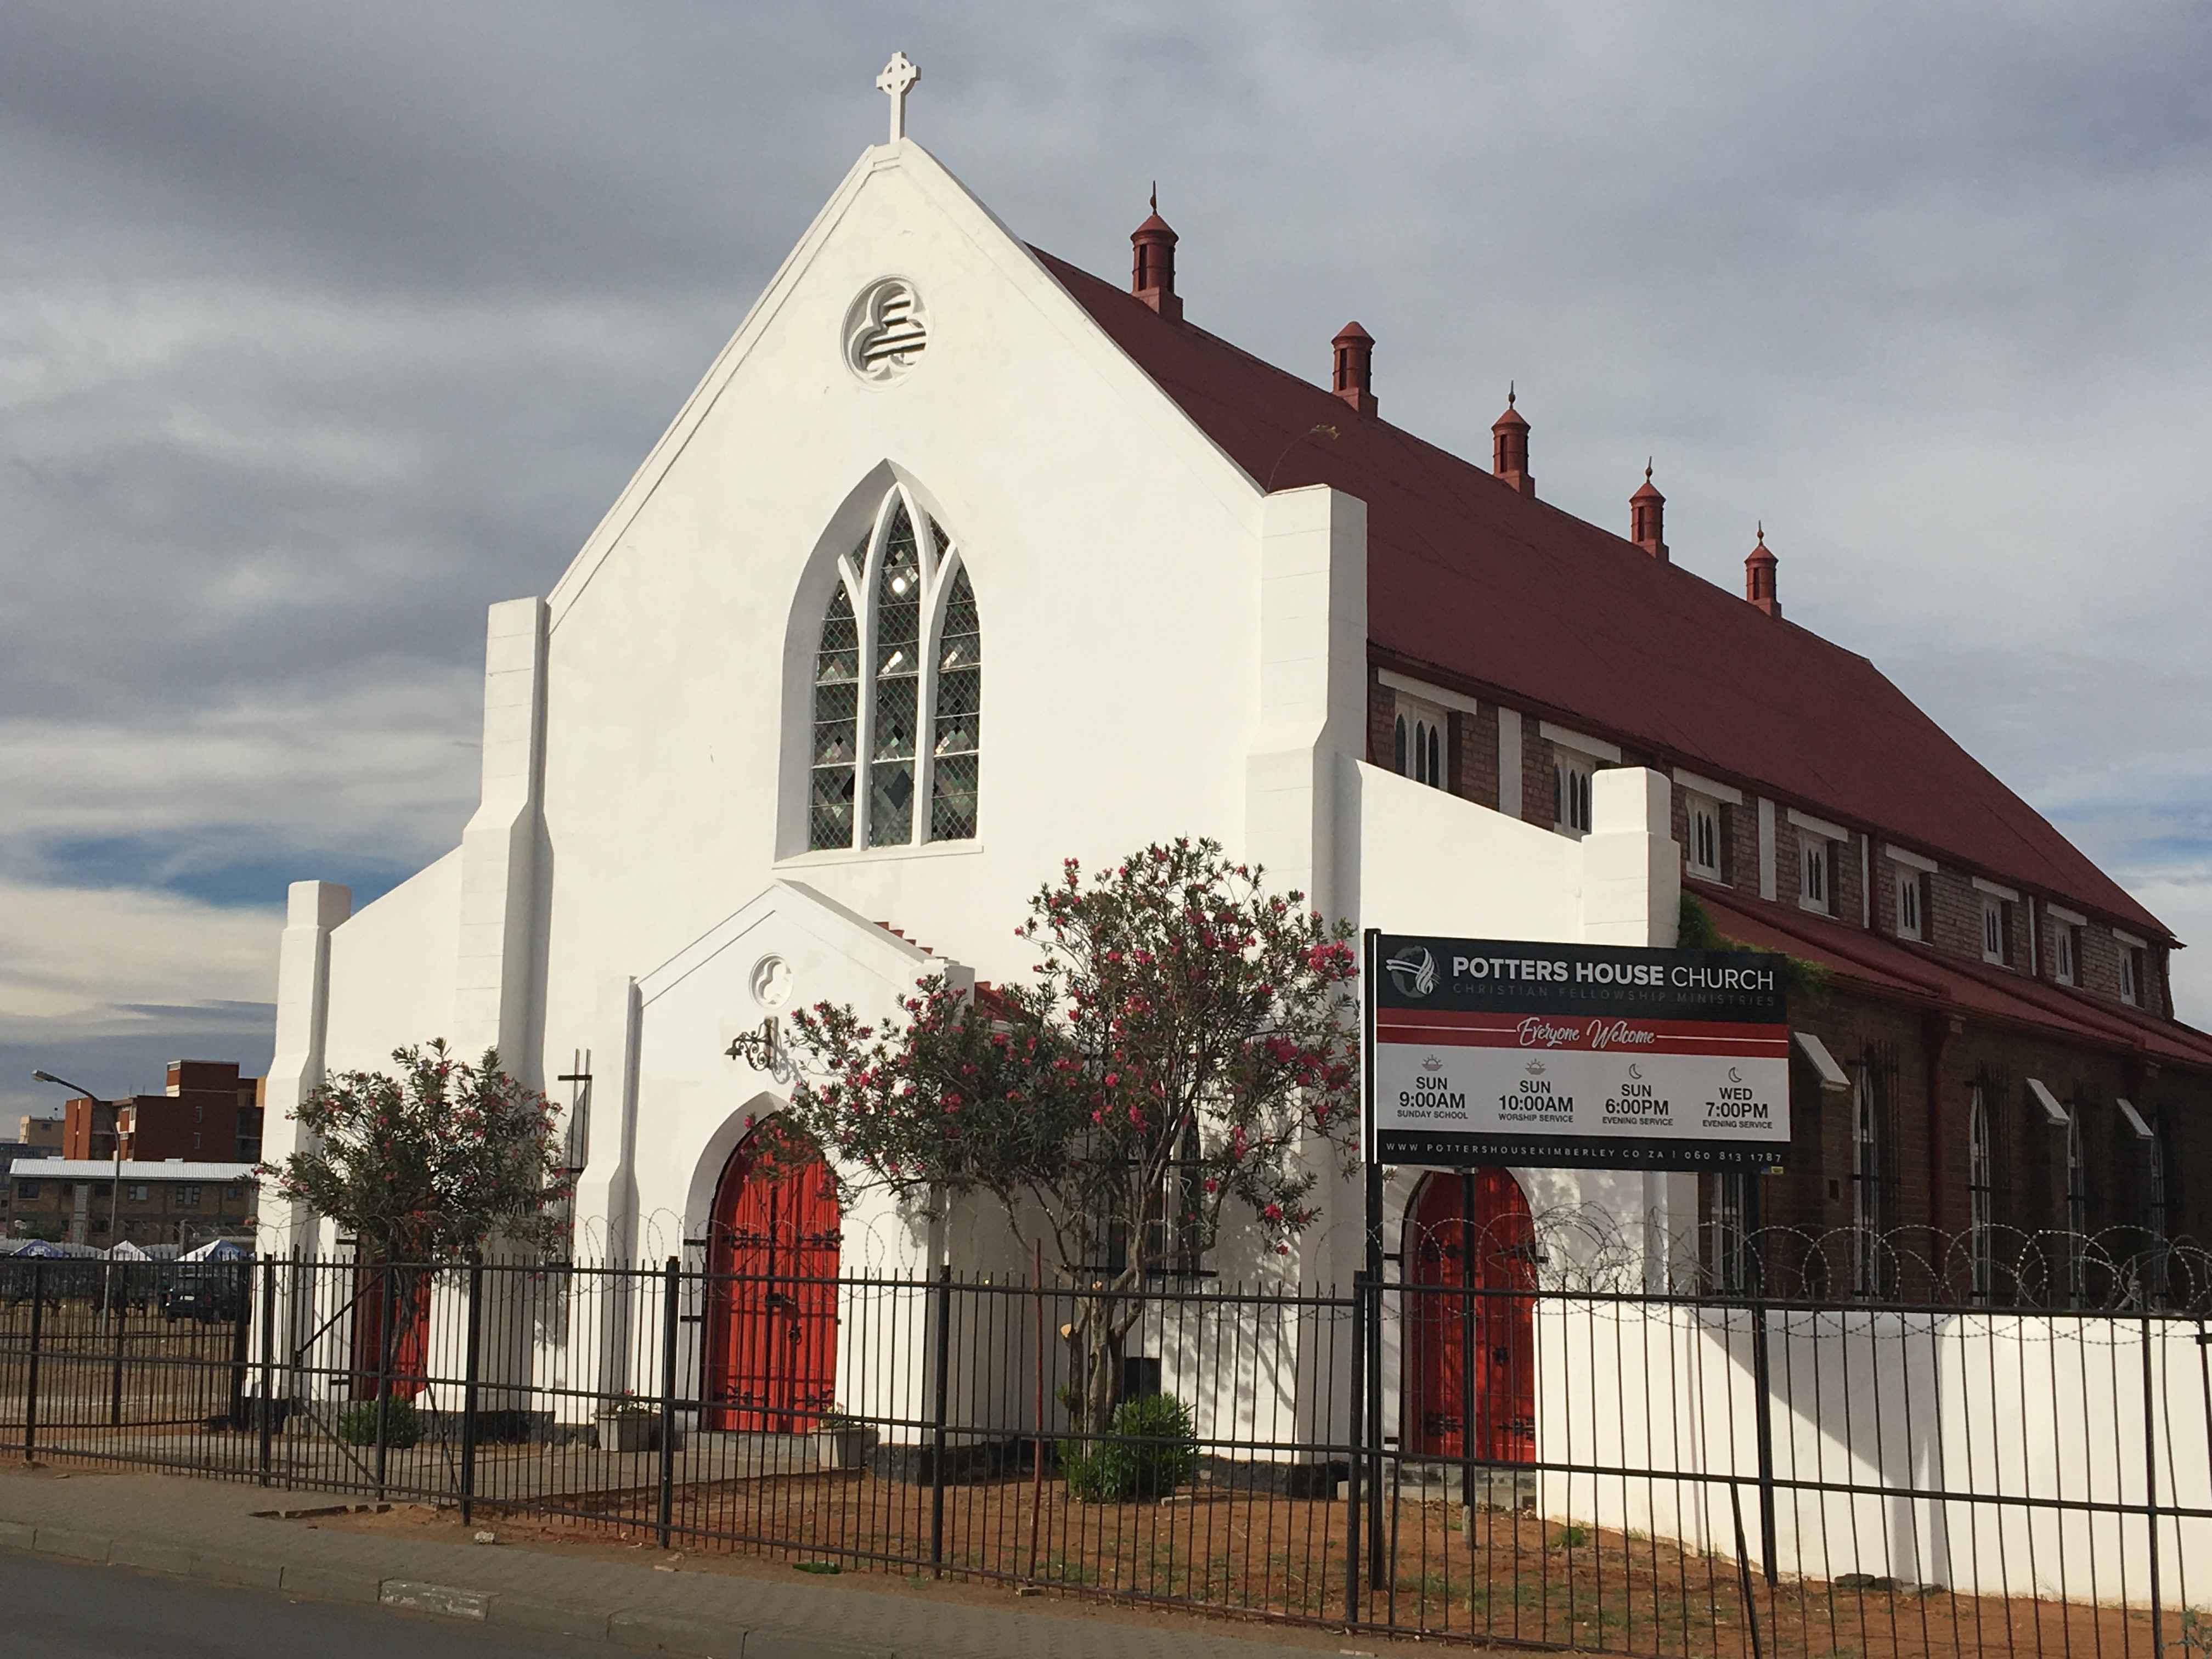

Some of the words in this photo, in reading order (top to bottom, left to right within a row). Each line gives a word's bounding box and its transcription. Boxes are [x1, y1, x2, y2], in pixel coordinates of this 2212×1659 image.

[1453, 956, 1569, 982] POTTERS
[1576, 962, 1664, 986] HOUSE
[1671, 966, 1774, 990] CHURCH
[1453, 983, 1548, 997] CHRISTIAN
[1559, 988, 1666, 1002] FELLOWSHIP
[1677, 992, 1774, 1007] MINISTRIES
[1517, 1017, 1580, 1047] Everyone
[1586, 1019, 1655, 1049] Welcome
[1416, 1076, 1448, 1090] SUN
[1519, 1080, 1551, 1094] SUN
[1621, 1084, 1652, 1097] SUN
[1719, 1087, 1753, 1101] WED
[1399, 1091, 1465, 1109] 9:00AM
[1499, 1095, 1573, 1113] 10:00AM
[1605, 1098, 1669, 1116] 6:00PM
[1397, 1110, 1431, 1119] SUNDAY
[1434, 1111, 1469, 1120] SCHOOL
[1705, 1102, 1768, 1119] 7:00PM
[1498, 1113, 1536, 1122] WORSHIP
[1539, 1114, 1573, 1123] SERVICE
[1602, 1116, 1637, 1125] EVENING
[1639, 1118, 1673, 1126] SERVICE
[1702, 1120, 1737, 1128] EVENING
[1739, 1121, 1773, 1130] SERVICE
[1719, 1152, 1742, 1162] 813
[1750, 1152, 1781, 1163] 1787
